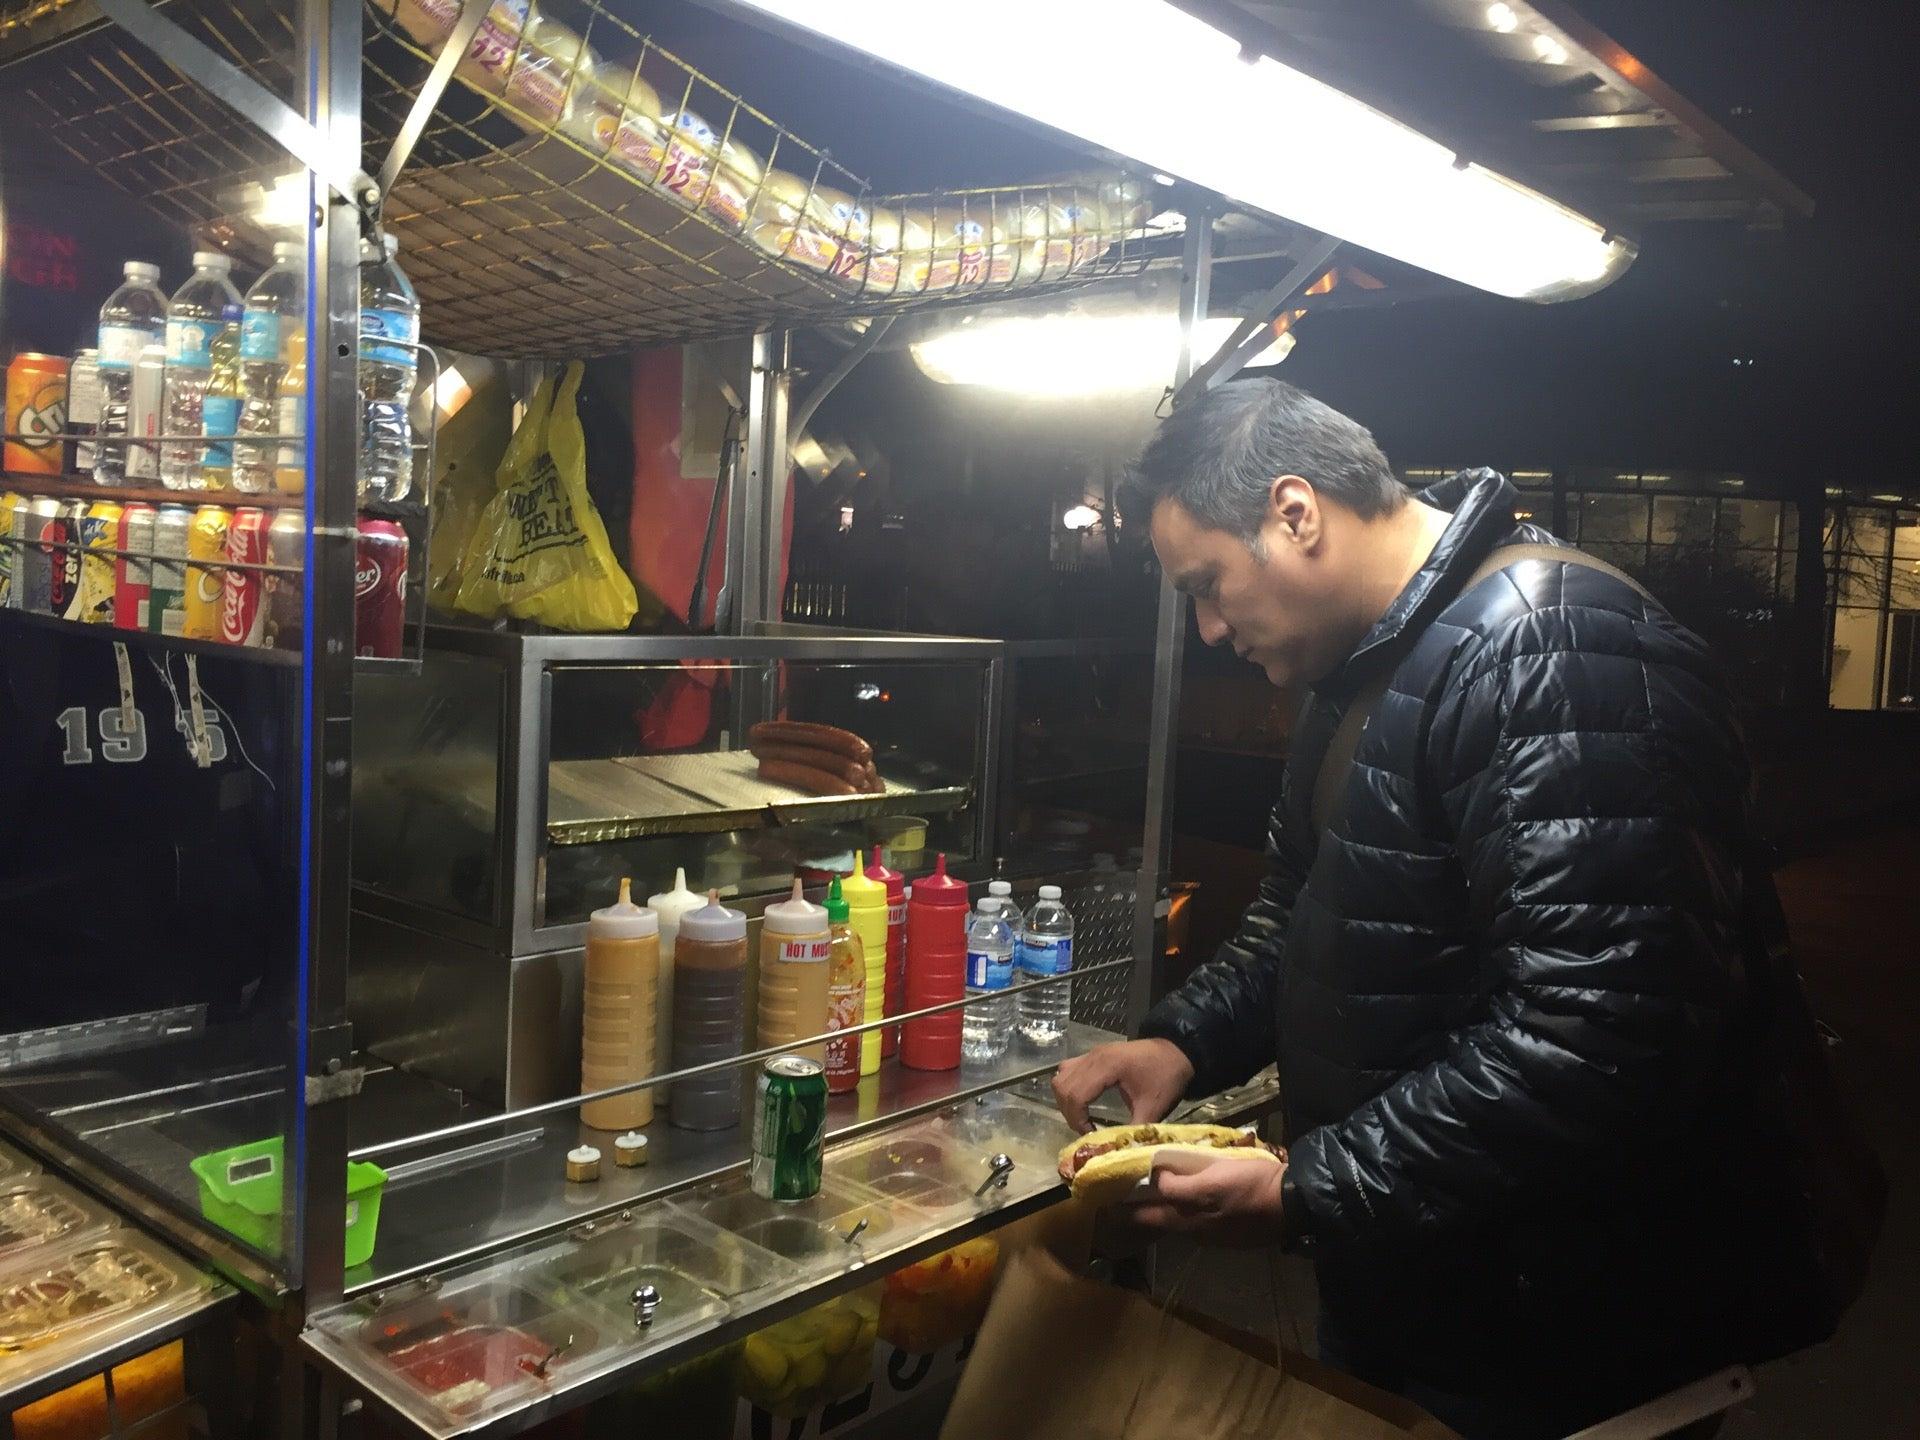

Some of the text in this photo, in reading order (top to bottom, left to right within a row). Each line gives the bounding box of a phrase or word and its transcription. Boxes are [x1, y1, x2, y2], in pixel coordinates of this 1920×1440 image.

[470, 37, 506, 74] 12
[661, 163, 691, 195] 12
[831, 252, 857, 280] 12
[786, 943, 806, 958] HOT
